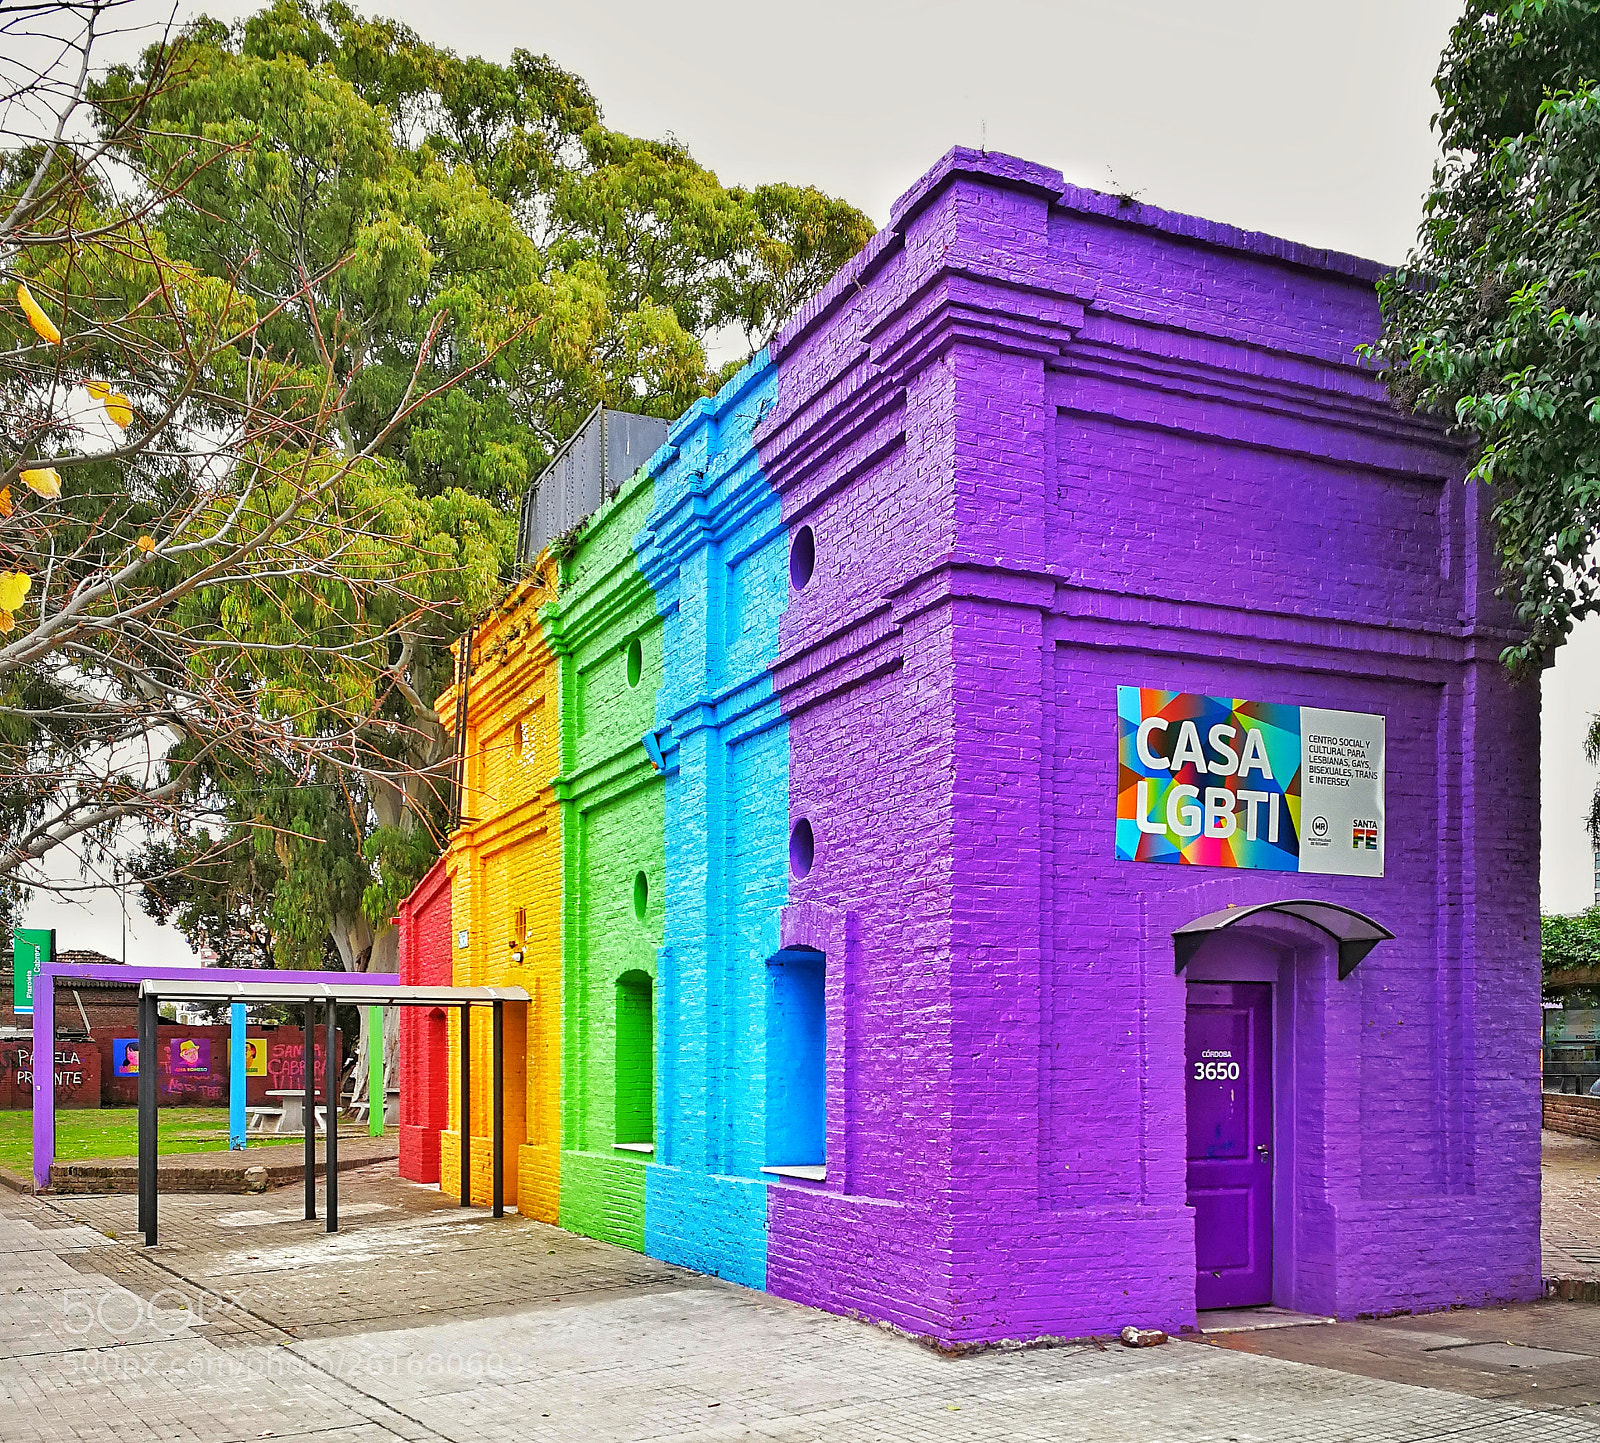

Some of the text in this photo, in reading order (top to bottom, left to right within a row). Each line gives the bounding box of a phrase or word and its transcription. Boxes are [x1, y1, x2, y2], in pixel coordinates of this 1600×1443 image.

[1136, 717, 1273, 780] CASA
[1308, 734, 1371, 749] CENTRO SOCIAL Y
[1308, 745, 1366, 758] CULTURAL PARA
[1308, 755, 1371, 770] LESBIANAS, GAYS,
[1308, 765, 1378, 780] BISEXUALES, TRANS
[1308, 776, 1350, 787] E INTERSEX
[1136, 780, 1280, 843] LGBTI
[1352, 819, 1378, 829] SANTA
[1352, 828, 1378, 850] FE
[1193, 1061, 1240, 1080] 3650
